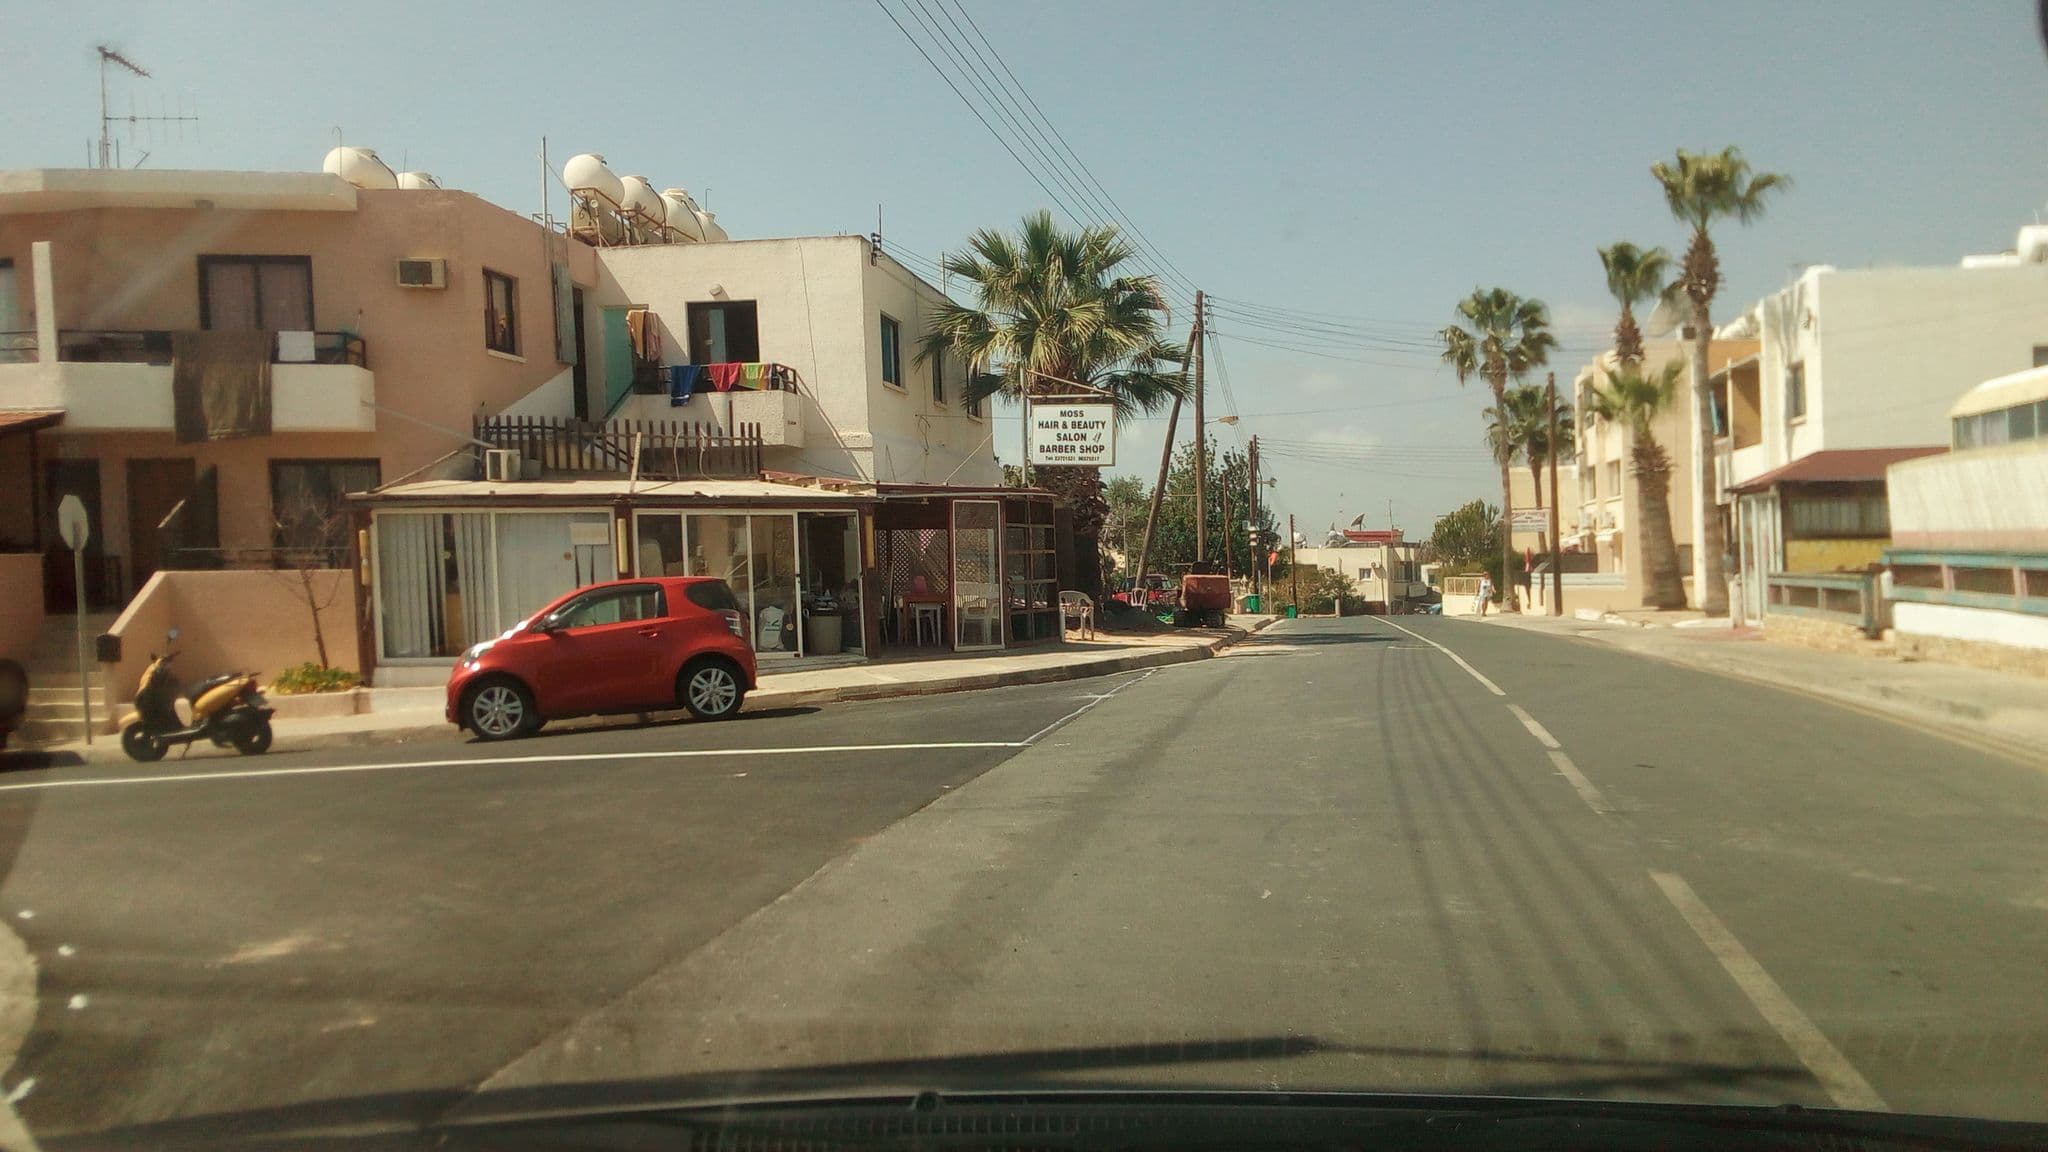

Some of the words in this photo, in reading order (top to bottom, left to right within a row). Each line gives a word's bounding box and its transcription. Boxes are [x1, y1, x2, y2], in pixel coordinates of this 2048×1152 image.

[1038, 421, 1059, 429] HAIR
[1061, 421, 1068, 429] &
[1071, 421, 1106, 429] BEAUTY
[1056, 433, 1087, 441] SALON
[1039, 445, 1076, 453] BARBER
[1079, 445, 1105, 453] SHOP
